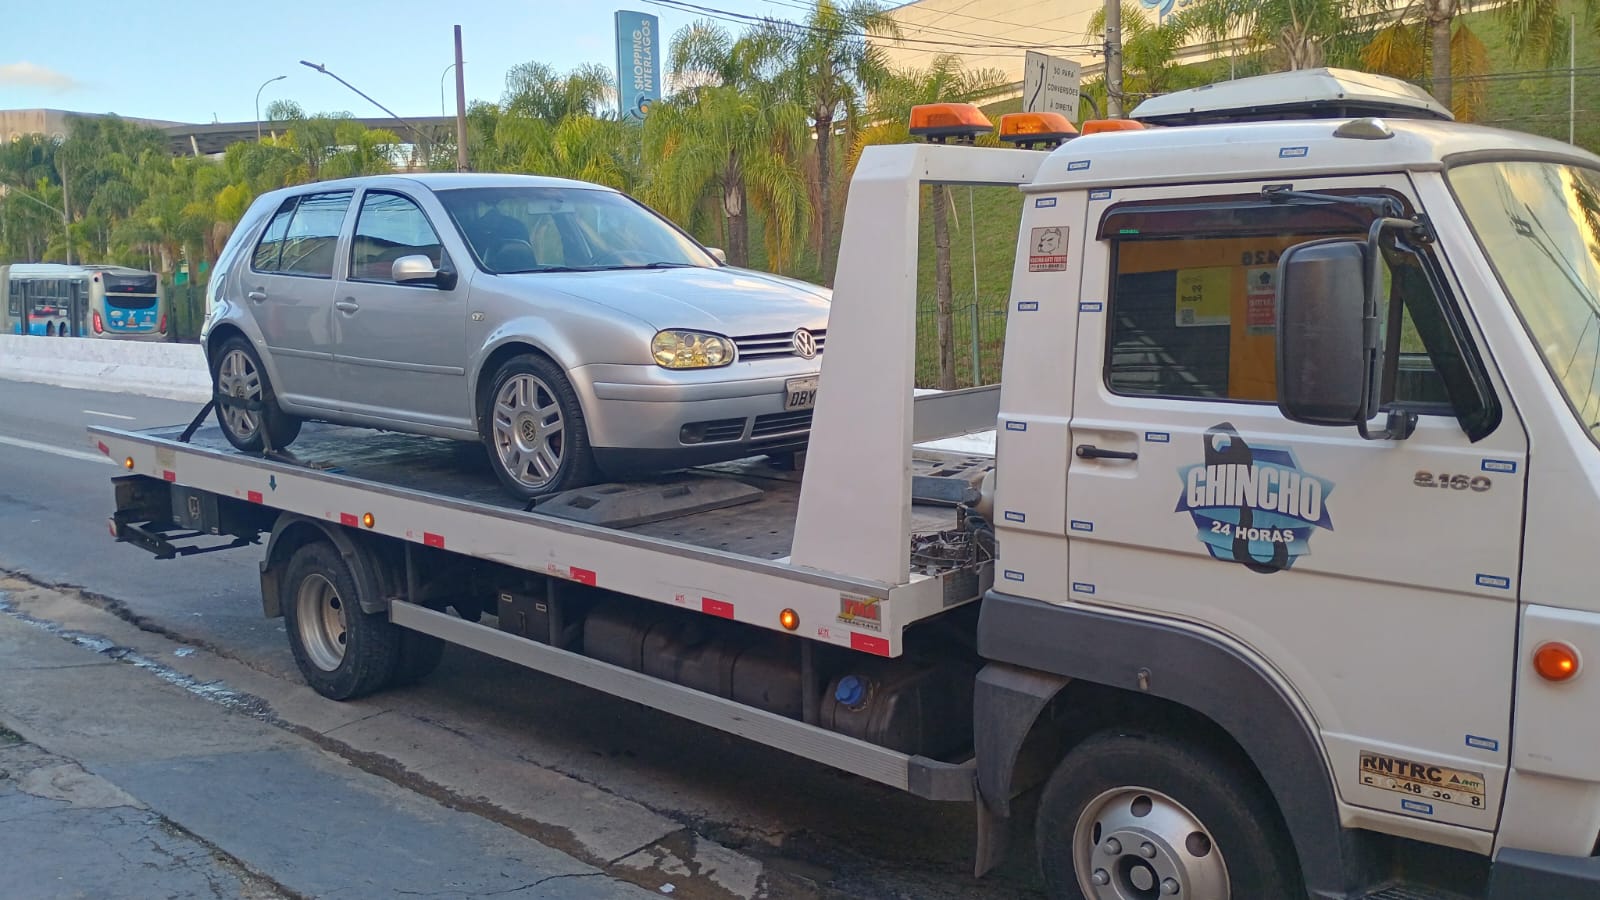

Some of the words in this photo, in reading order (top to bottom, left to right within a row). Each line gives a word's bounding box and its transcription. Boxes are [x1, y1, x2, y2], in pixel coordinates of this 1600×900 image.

[633, 30, 643, 90] SHOPPING
[642, 20, 653, 91] INTERLAGOS
[1062, 69, 1074, 78] PARA
[1055, 102, 1072, 112] DIREITA
[789, 389, 817, 407] DBY
[1211, 520, 1231, 536] 24
[1235, 526, 1295, 543] HORAS
[1363, 757, 1442, 782] RNTRC
